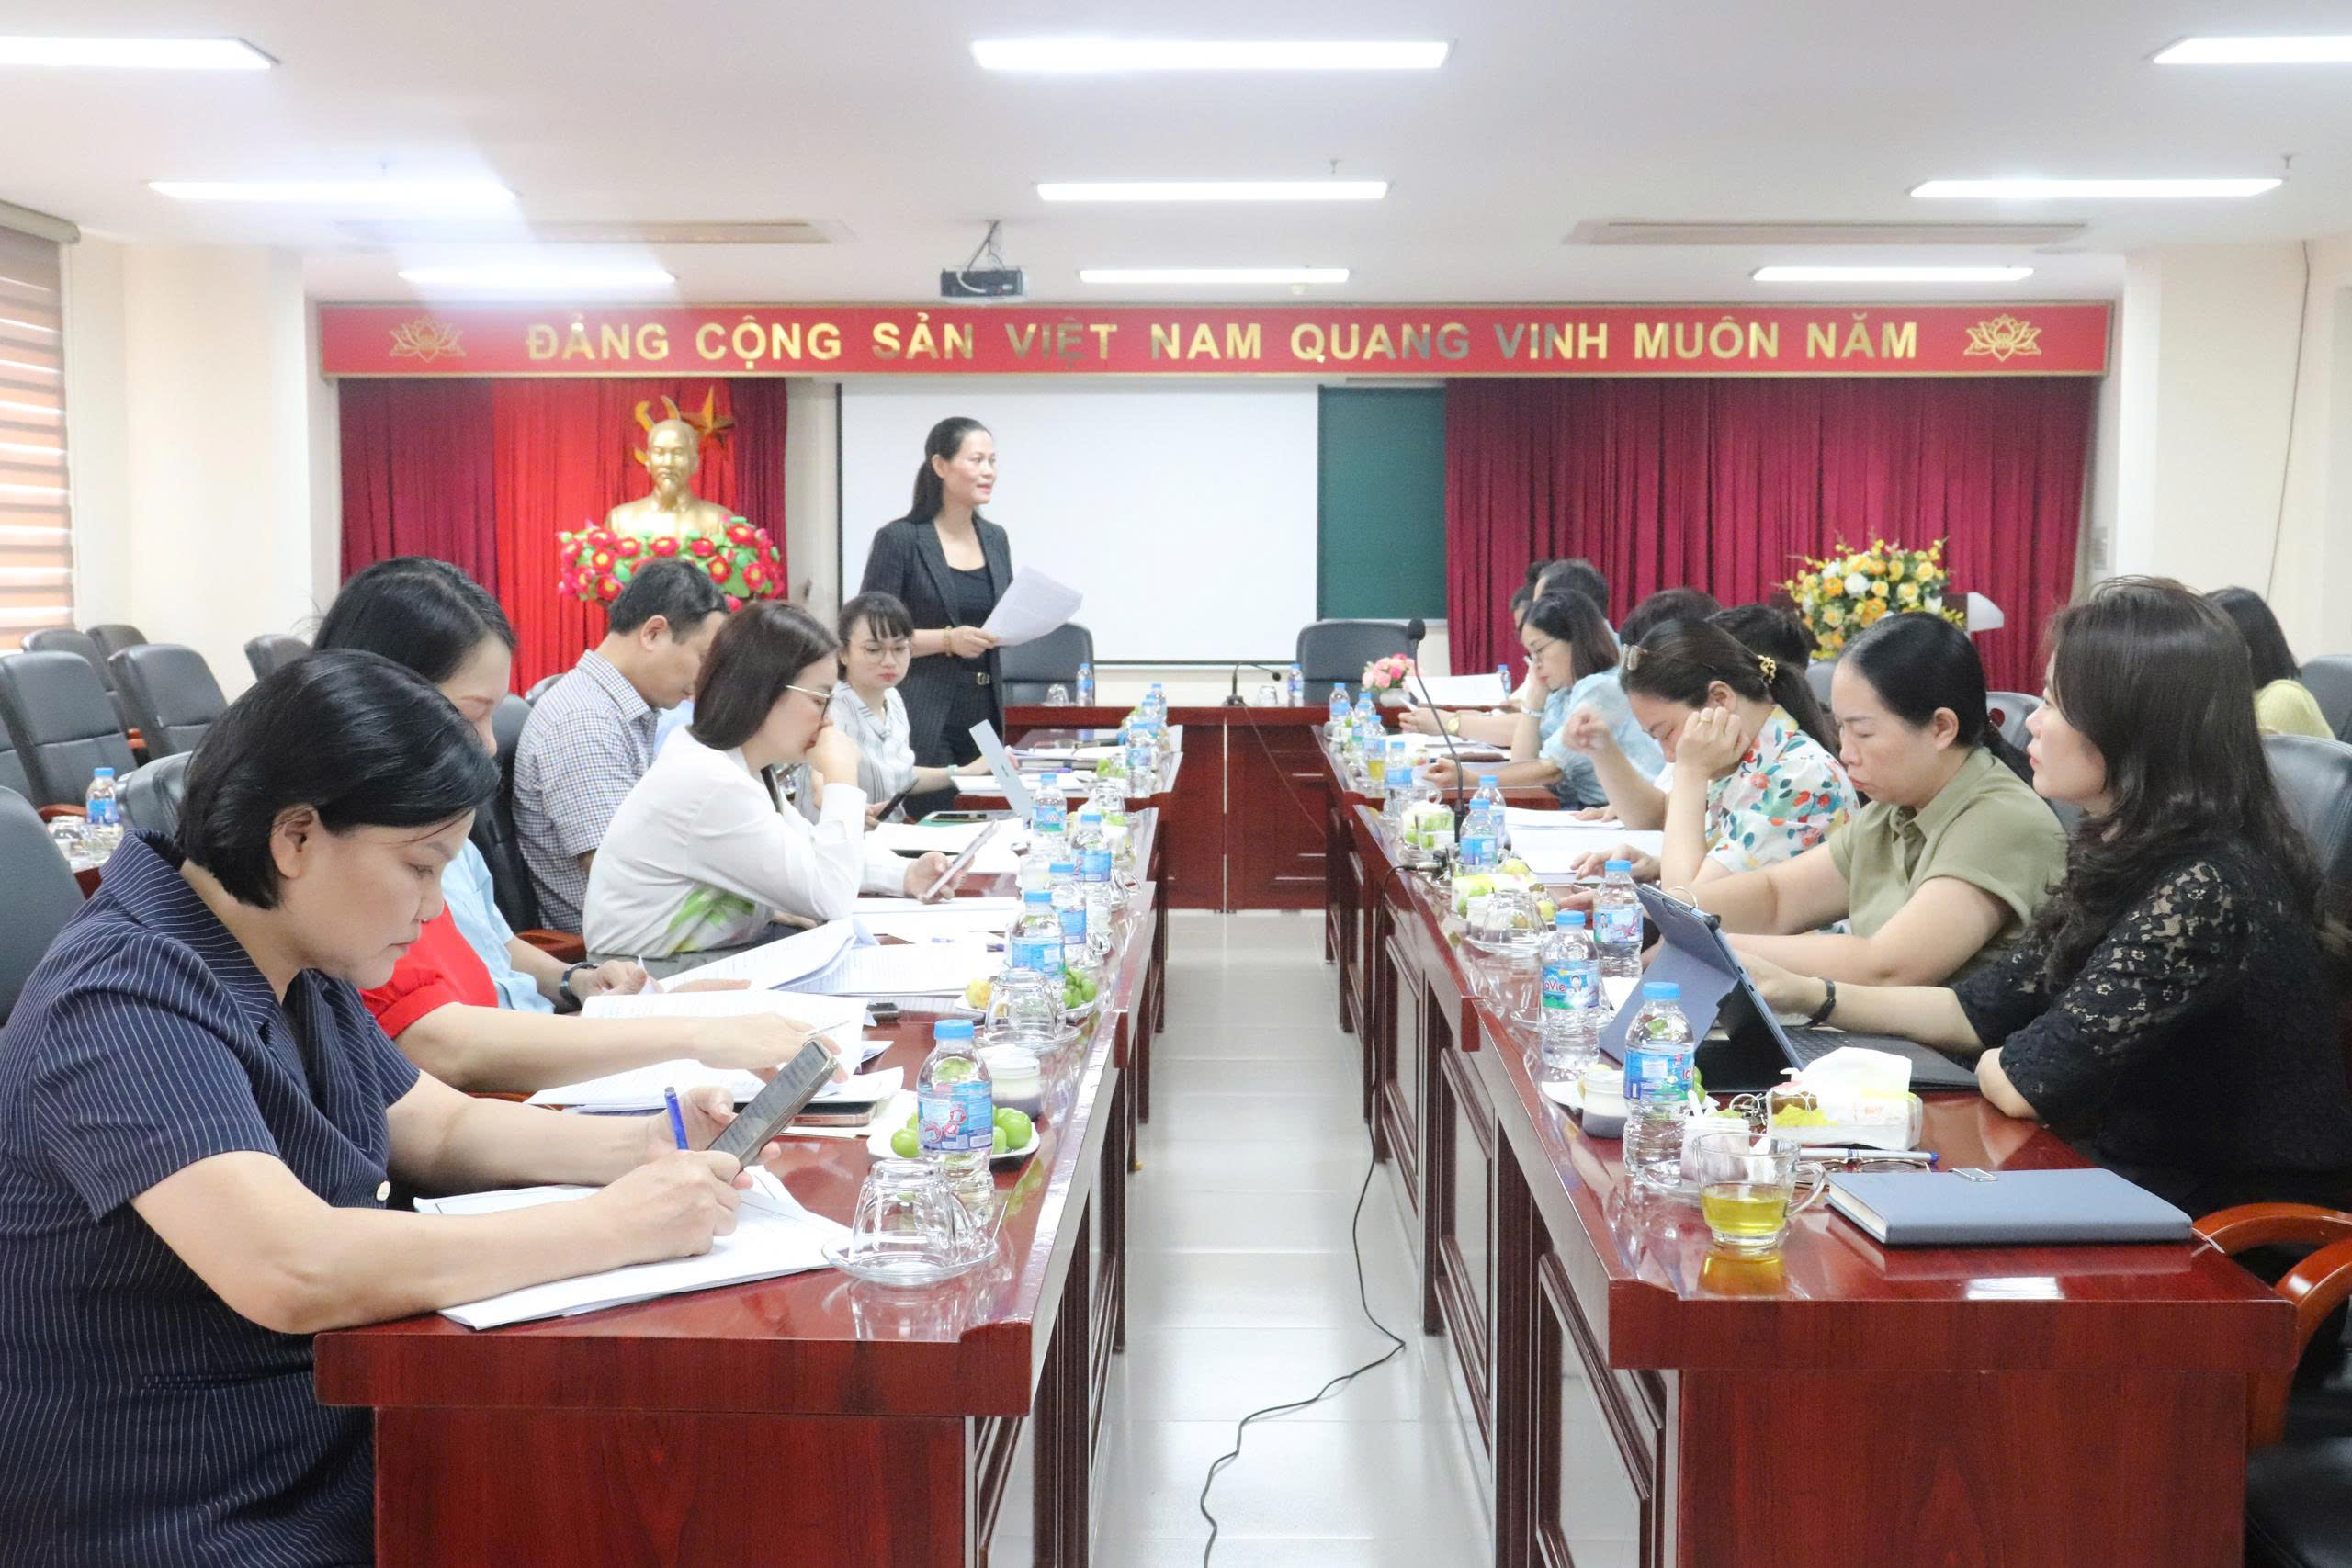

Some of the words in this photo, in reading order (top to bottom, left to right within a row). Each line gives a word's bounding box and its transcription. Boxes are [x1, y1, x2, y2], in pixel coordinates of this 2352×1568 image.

[526, 311, 670, 361] ĐẢNG
[695, 315, 842, 368] CỘNG
[871, 312, 974, 360] SẢN
[1004, 315, 1119, 368] VIỆT
[1150, 322, 1262, 360] NAM
[1290, 322, 1471, 364] QUANG
[1494, 322, 1609, 360] VINH
[1634, 315, 1780, 360] MUÔN
[1806, 311, 1918, 360] NĂM
